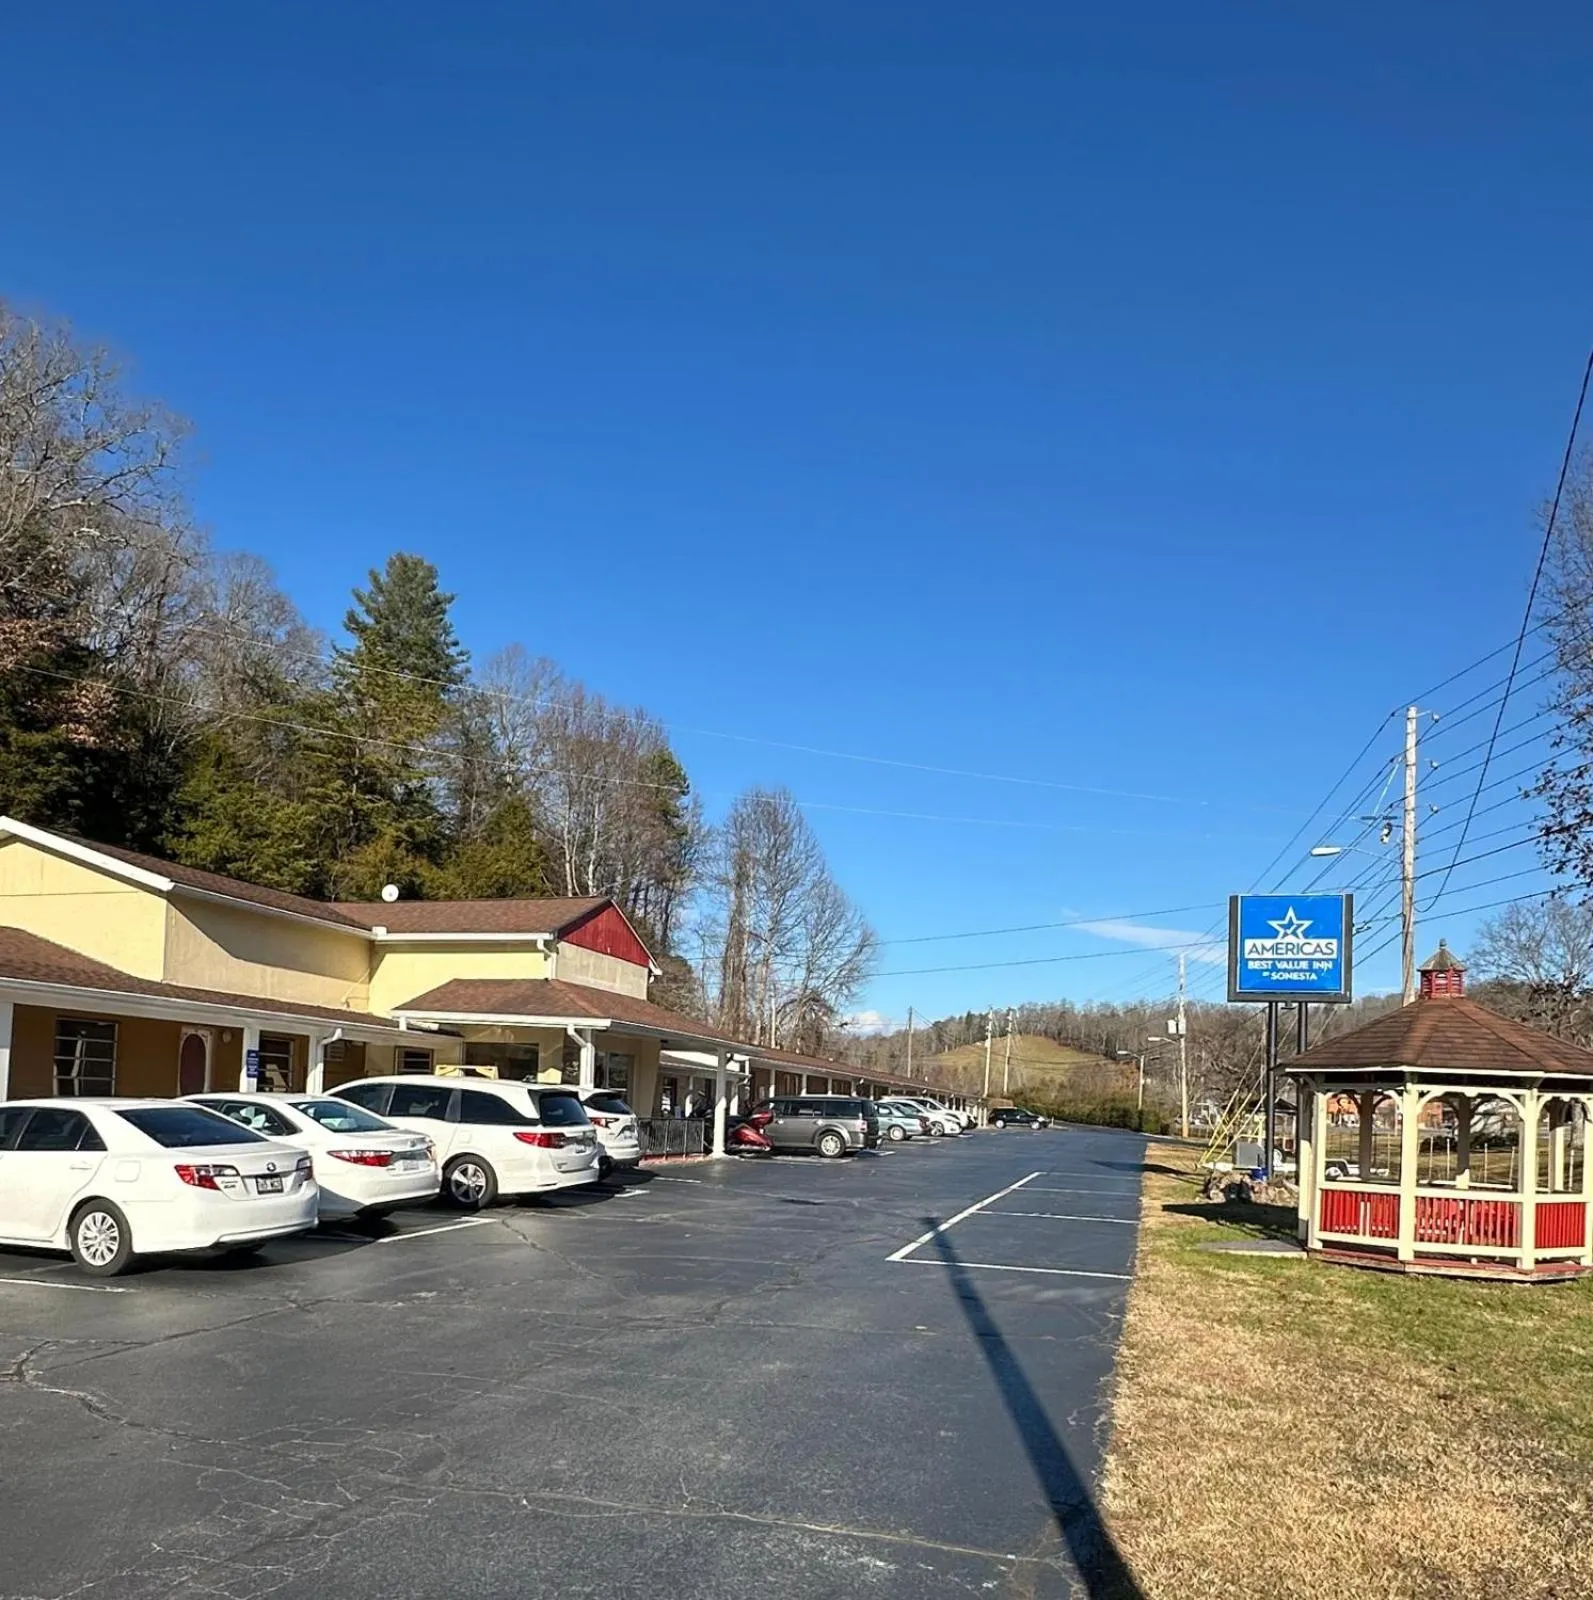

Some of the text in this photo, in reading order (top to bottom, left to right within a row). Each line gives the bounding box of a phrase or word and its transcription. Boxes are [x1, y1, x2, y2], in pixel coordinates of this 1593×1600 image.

[1247, 942, 1335, 956] AMERICAS
[1247, 961, 1333, 970] BEST VALUE INN
[1270, 972, 1318, 981] SONESTA
